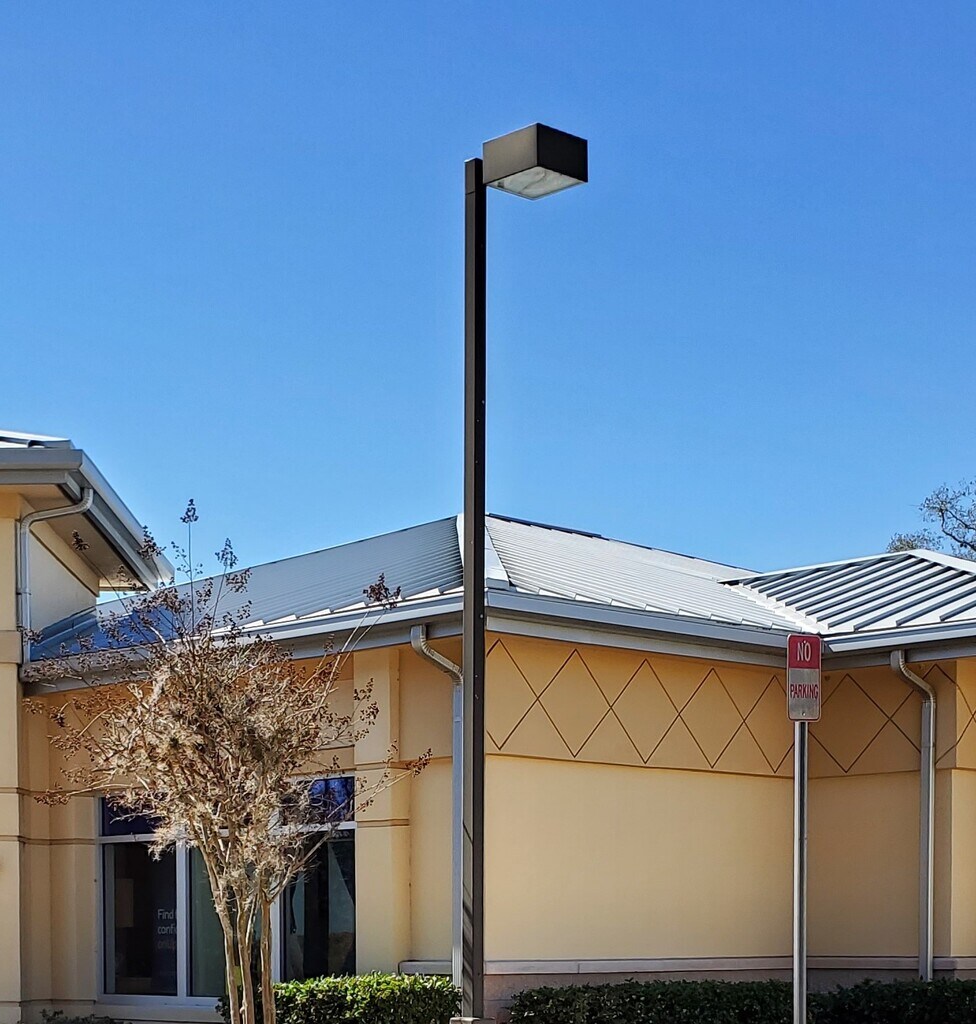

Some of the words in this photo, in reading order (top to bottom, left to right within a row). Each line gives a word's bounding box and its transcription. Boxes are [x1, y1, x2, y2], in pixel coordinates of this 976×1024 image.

[797, 642, 811, 662] NO
[790, 683, 819, 699] PARKING
[157, 908, 174, 920] Find
